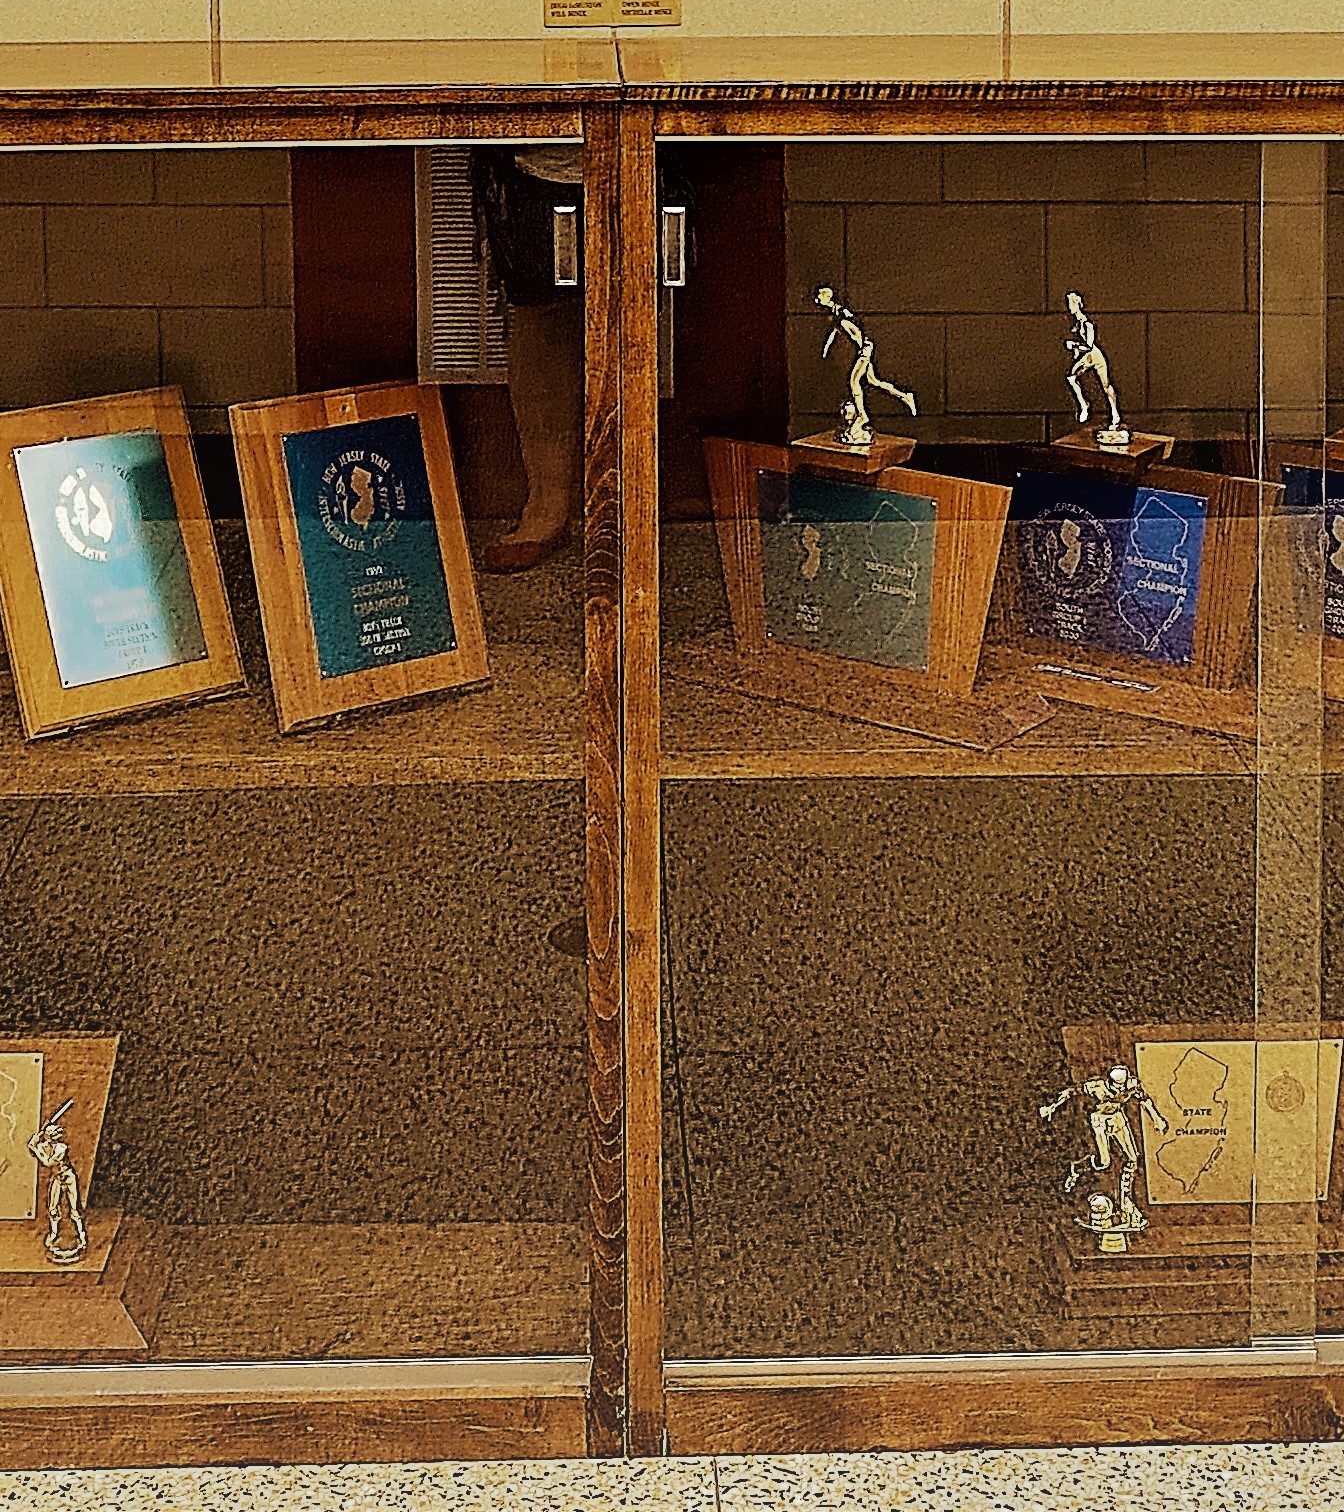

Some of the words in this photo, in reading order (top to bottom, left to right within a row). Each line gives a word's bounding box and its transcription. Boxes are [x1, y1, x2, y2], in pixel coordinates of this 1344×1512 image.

[1126, 556, 1179, 574] SECTIONAL
[1137, 580, 1187, 596] CHAMPION
[1182, 1108, 1212, 1116] STATE
[1175, 1128, 1227, 1137] CHAMPION
